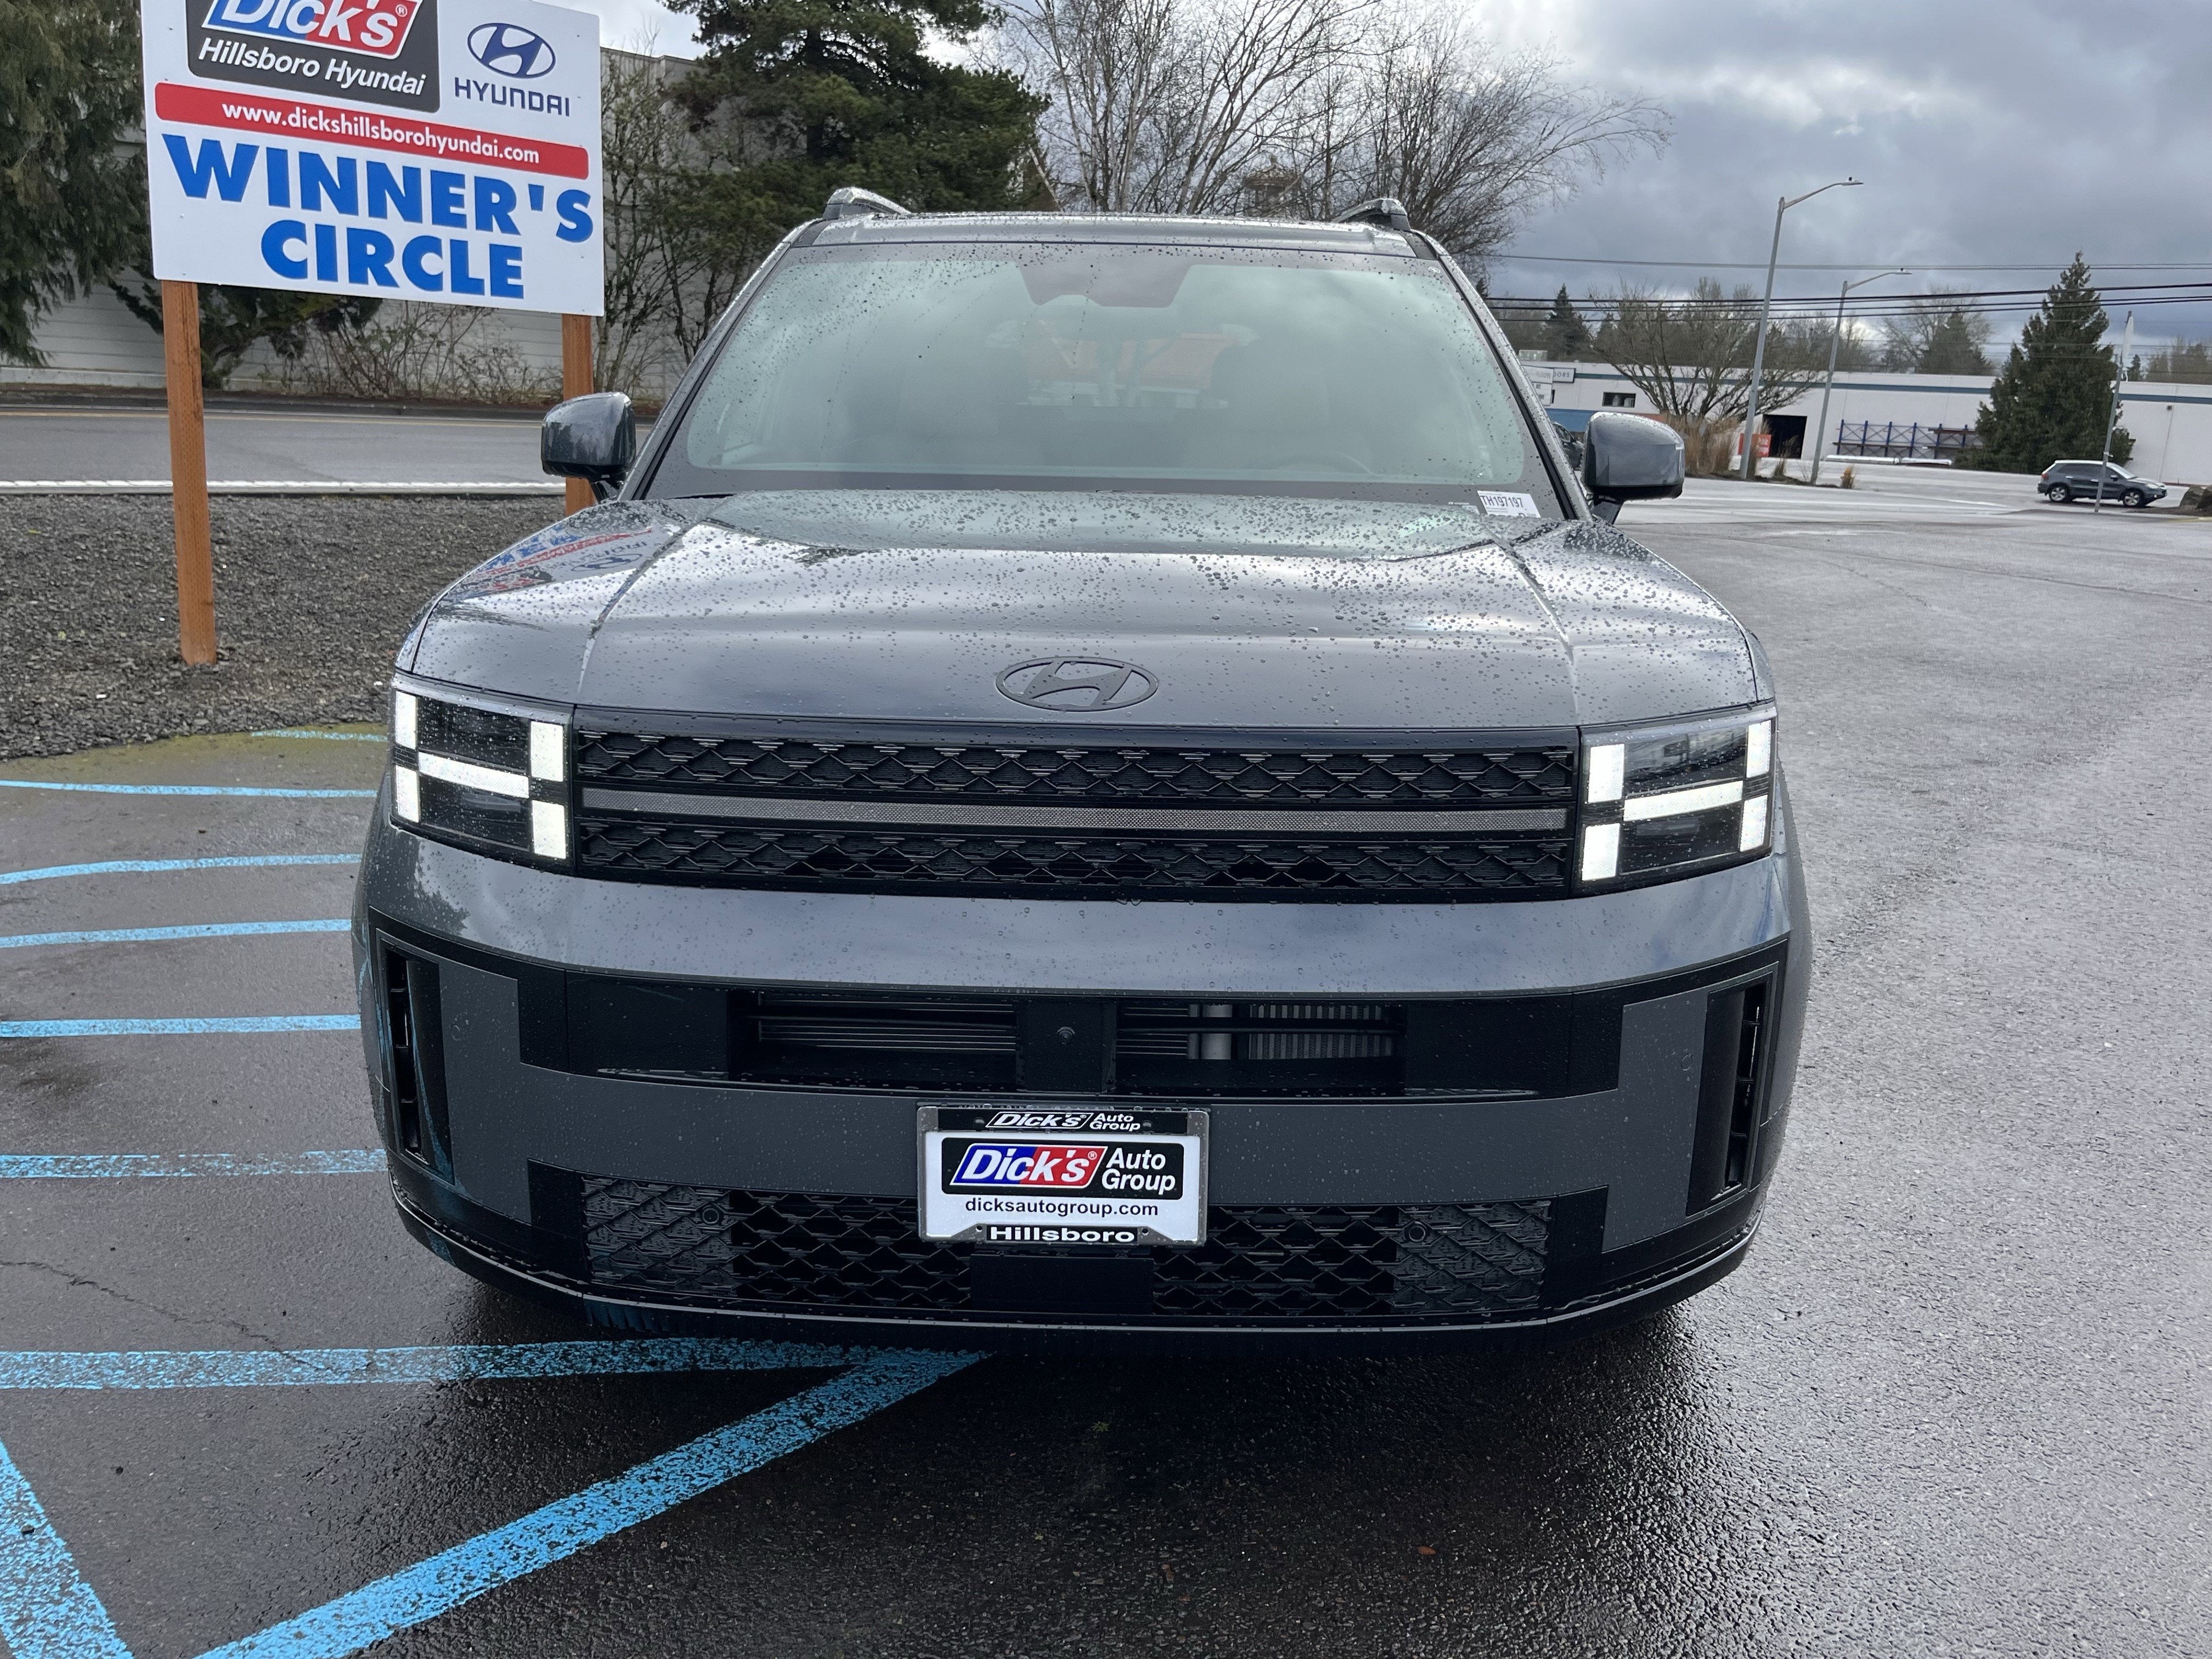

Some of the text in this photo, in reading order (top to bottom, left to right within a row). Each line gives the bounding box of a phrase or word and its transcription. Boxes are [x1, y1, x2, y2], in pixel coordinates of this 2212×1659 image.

[198, 37, 426, 95] Hillsboro Hyundai
[454, 77, 570, 117] HYUNDAI
[222, 103, 539, 163] www.dickshillsborohyundai.com
[161, 133, 594, 243] WINNER'S
[261, 219, 524, 300] CIRCLE
[1480, 495, 1524, 508] TH197197
[993, 1113, 1081, 1127] Dick's
[1090, 1120, 1141, 1132] Group
[1093, 1113, 1134, 1122] Auto
[961, 1148, 1090, 1182] Dick's
[1106, 1147, 1166, 1170] Auto
[1101, 1168, 1176, 1195] Group
[965, 1198, 1158, 1217] dicksautogroup.com
[990, 1226, 1135, 1243] Hillsboro
